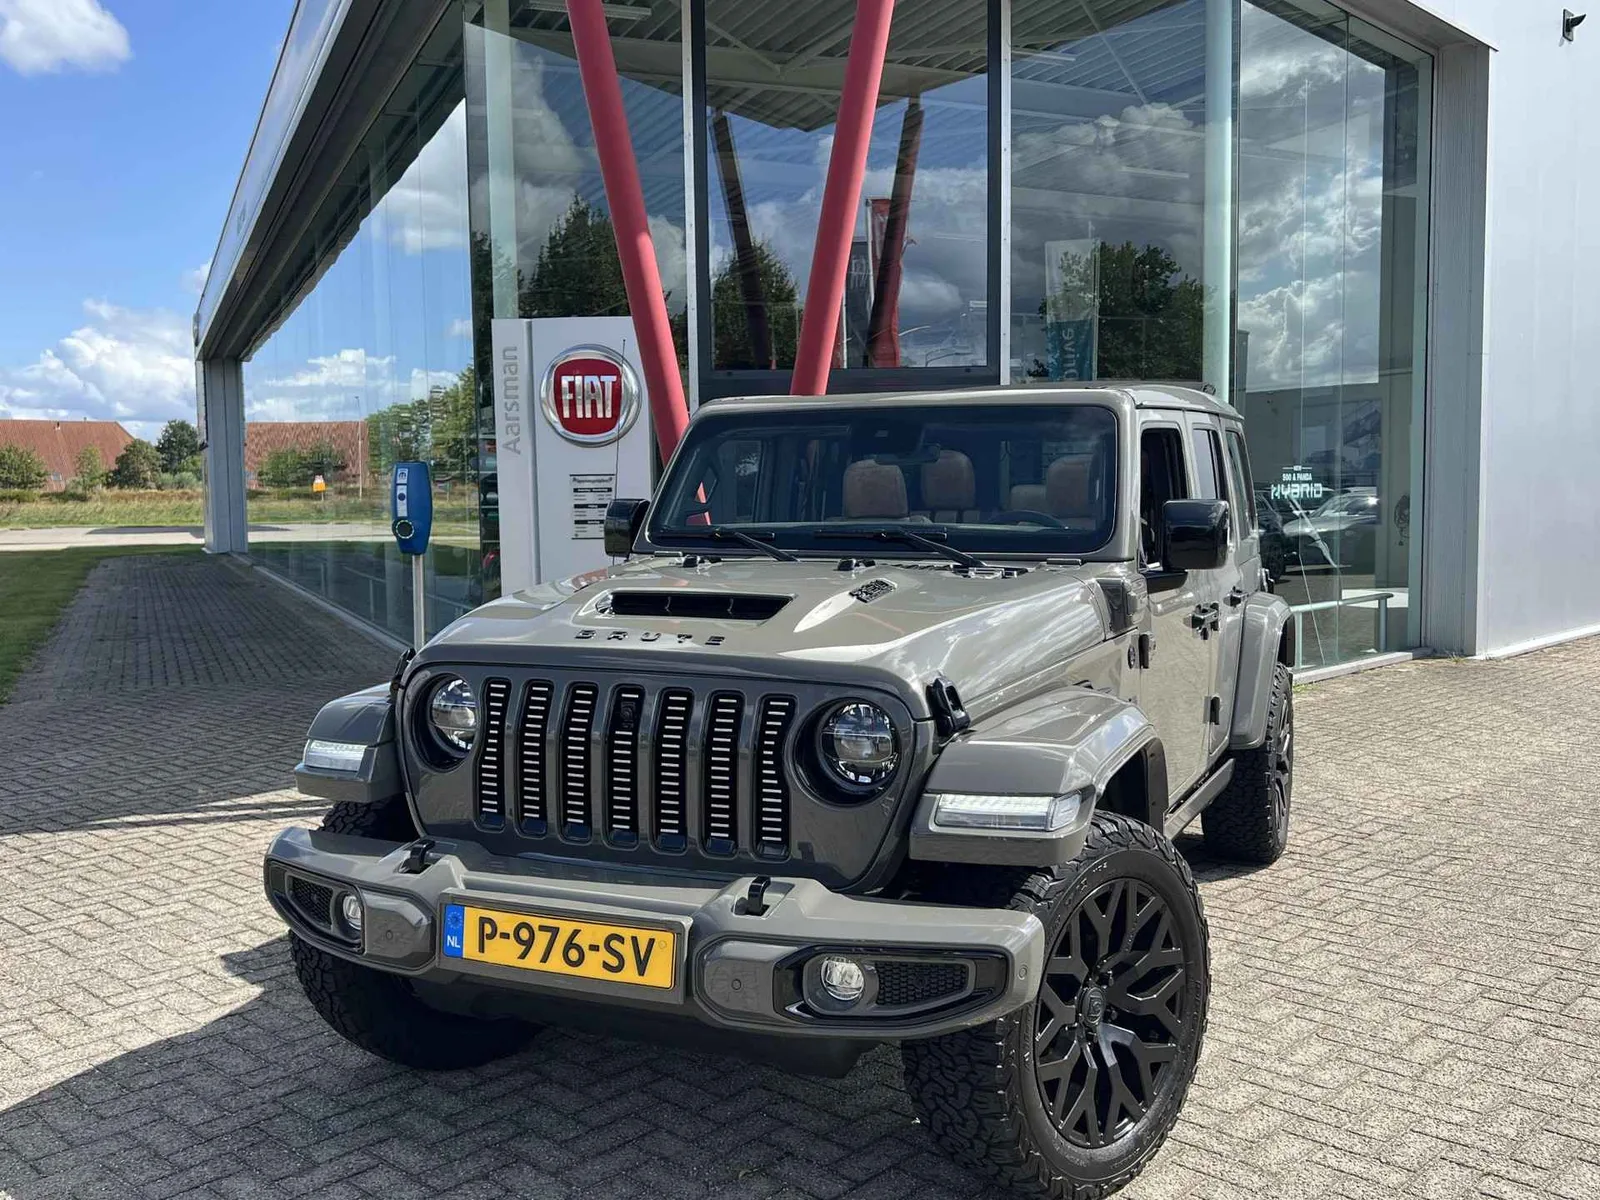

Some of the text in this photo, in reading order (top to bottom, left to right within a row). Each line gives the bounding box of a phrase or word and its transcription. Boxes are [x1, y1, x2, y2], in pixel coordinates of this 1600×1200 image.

[502, 345, 521, 455] Aarsman
[560, 375, 617, 419] FIAT
[1270, 483, 1323, 500] HYBRID
[1297, 473, 1312, 481] PANDA
[446, 935, 461, 949] NL
[478, 915, 656, 977] P-976-SV
